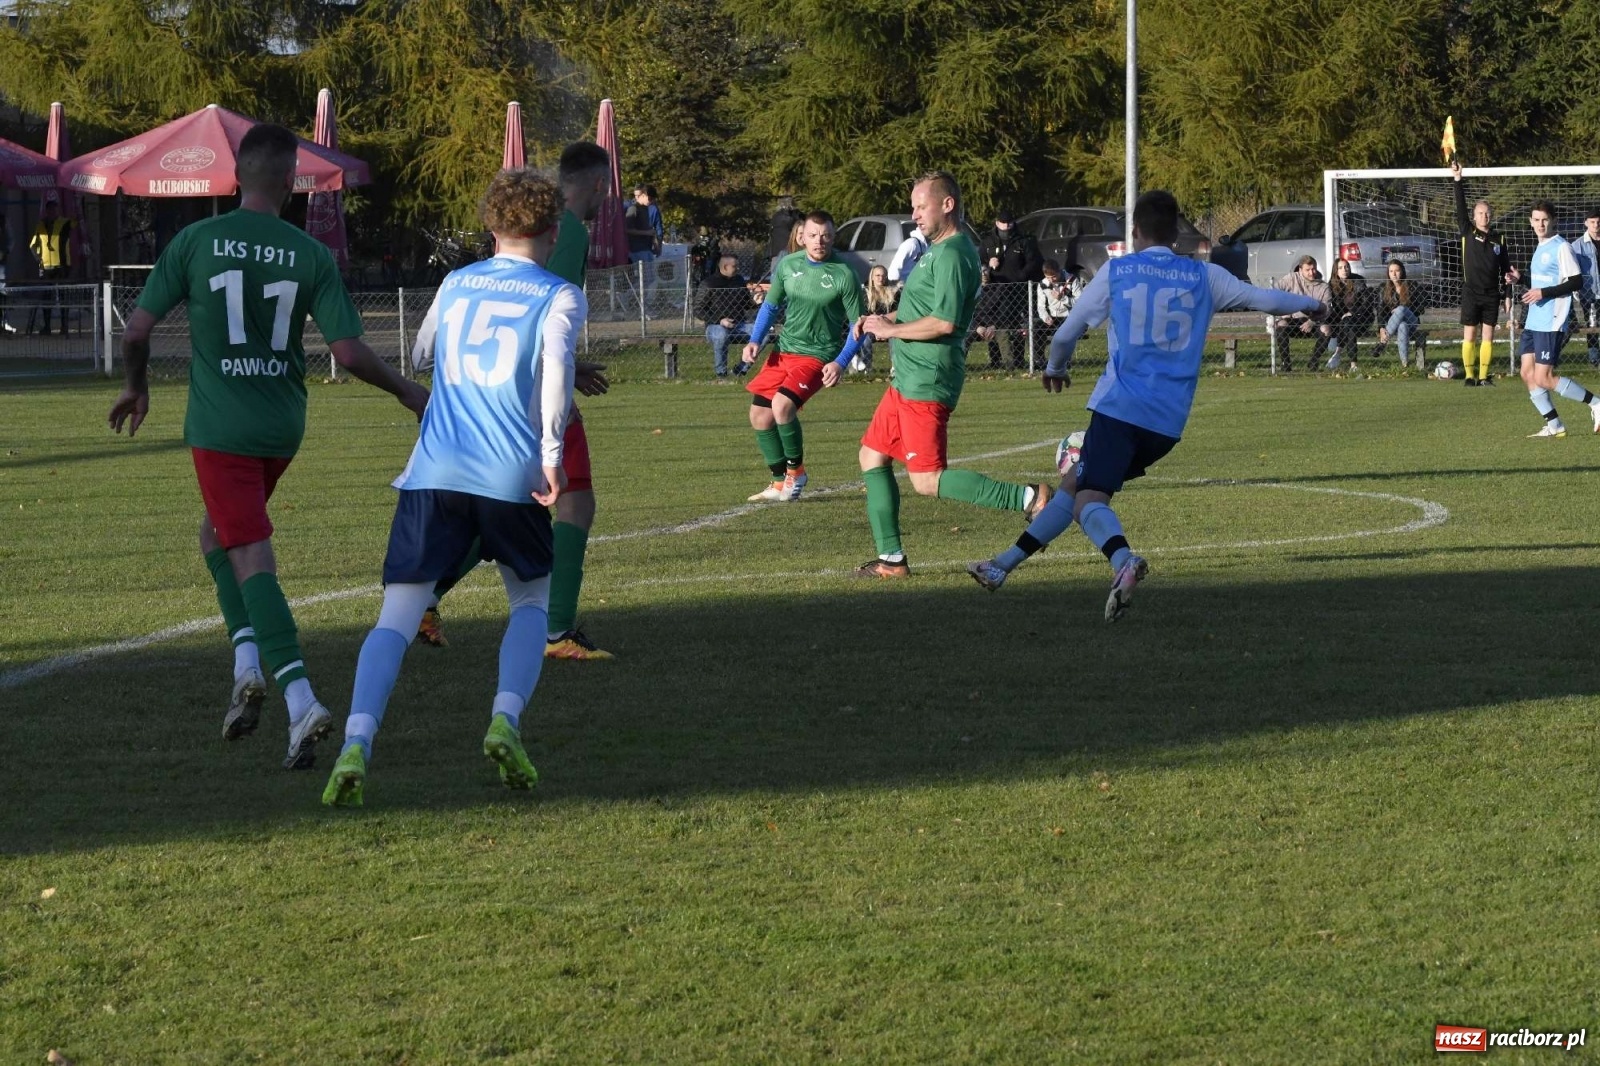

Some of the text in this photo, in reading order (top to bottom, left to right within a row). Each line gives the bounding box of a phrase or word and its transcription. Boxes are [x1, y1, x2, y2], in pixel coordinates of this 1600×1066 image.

[149, 179, 211, 194] RACIBORSKIE
[213, 238, 296, 268] LKS 1911
[1116, 264, 1134, 276] KS
[461, 274, 551, 298] KORNOWAC
[208, 269, 299, 351] 11
[1122, 282, 1195, 353] 16
[442, 297, 530, 388] 15
[1541, 350, 1551, 361] 14
